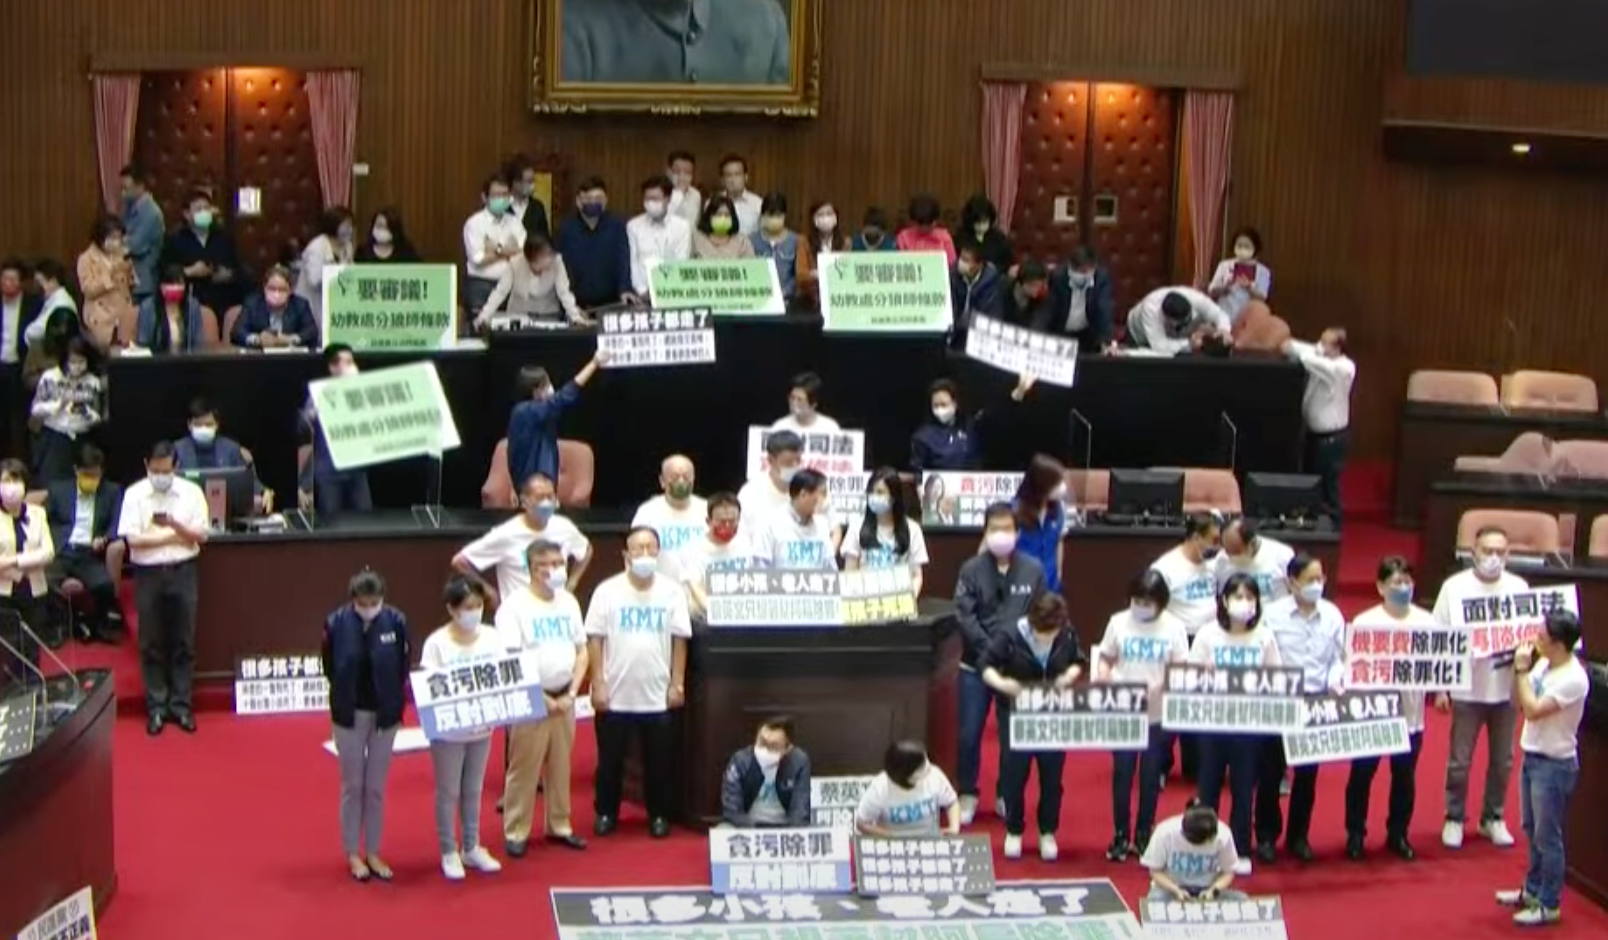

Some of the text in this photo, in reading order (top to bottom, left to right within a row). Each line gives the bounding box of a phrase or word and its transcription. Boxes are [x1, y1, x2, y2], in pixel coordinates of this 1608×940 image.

[358, 278, 428, 301] 要審議!
[787, 541, 823, 562] KMT
[532, 615, 572, 641] KMT
[620, 606, 667, 631] KMT
[1123, 637, 1168, 661] KMT
[1351, 630, 1467, 656] 機要費除罪化
[241, 655, 324, 678] 很多孩子都
[1215, 645, 1262, 667] KMT
[426, 657, 525, 700] 貪污除罪
[1351, 657, 1462, 685] 貪污除罪化!
[889, 798, 938, 824] KMT
[727, 832, 834, 858] 貪污除罪
[1172, 851, 1218, 873] KMT
[590, 887, 1089, 925] 很多小孩、老人走了
